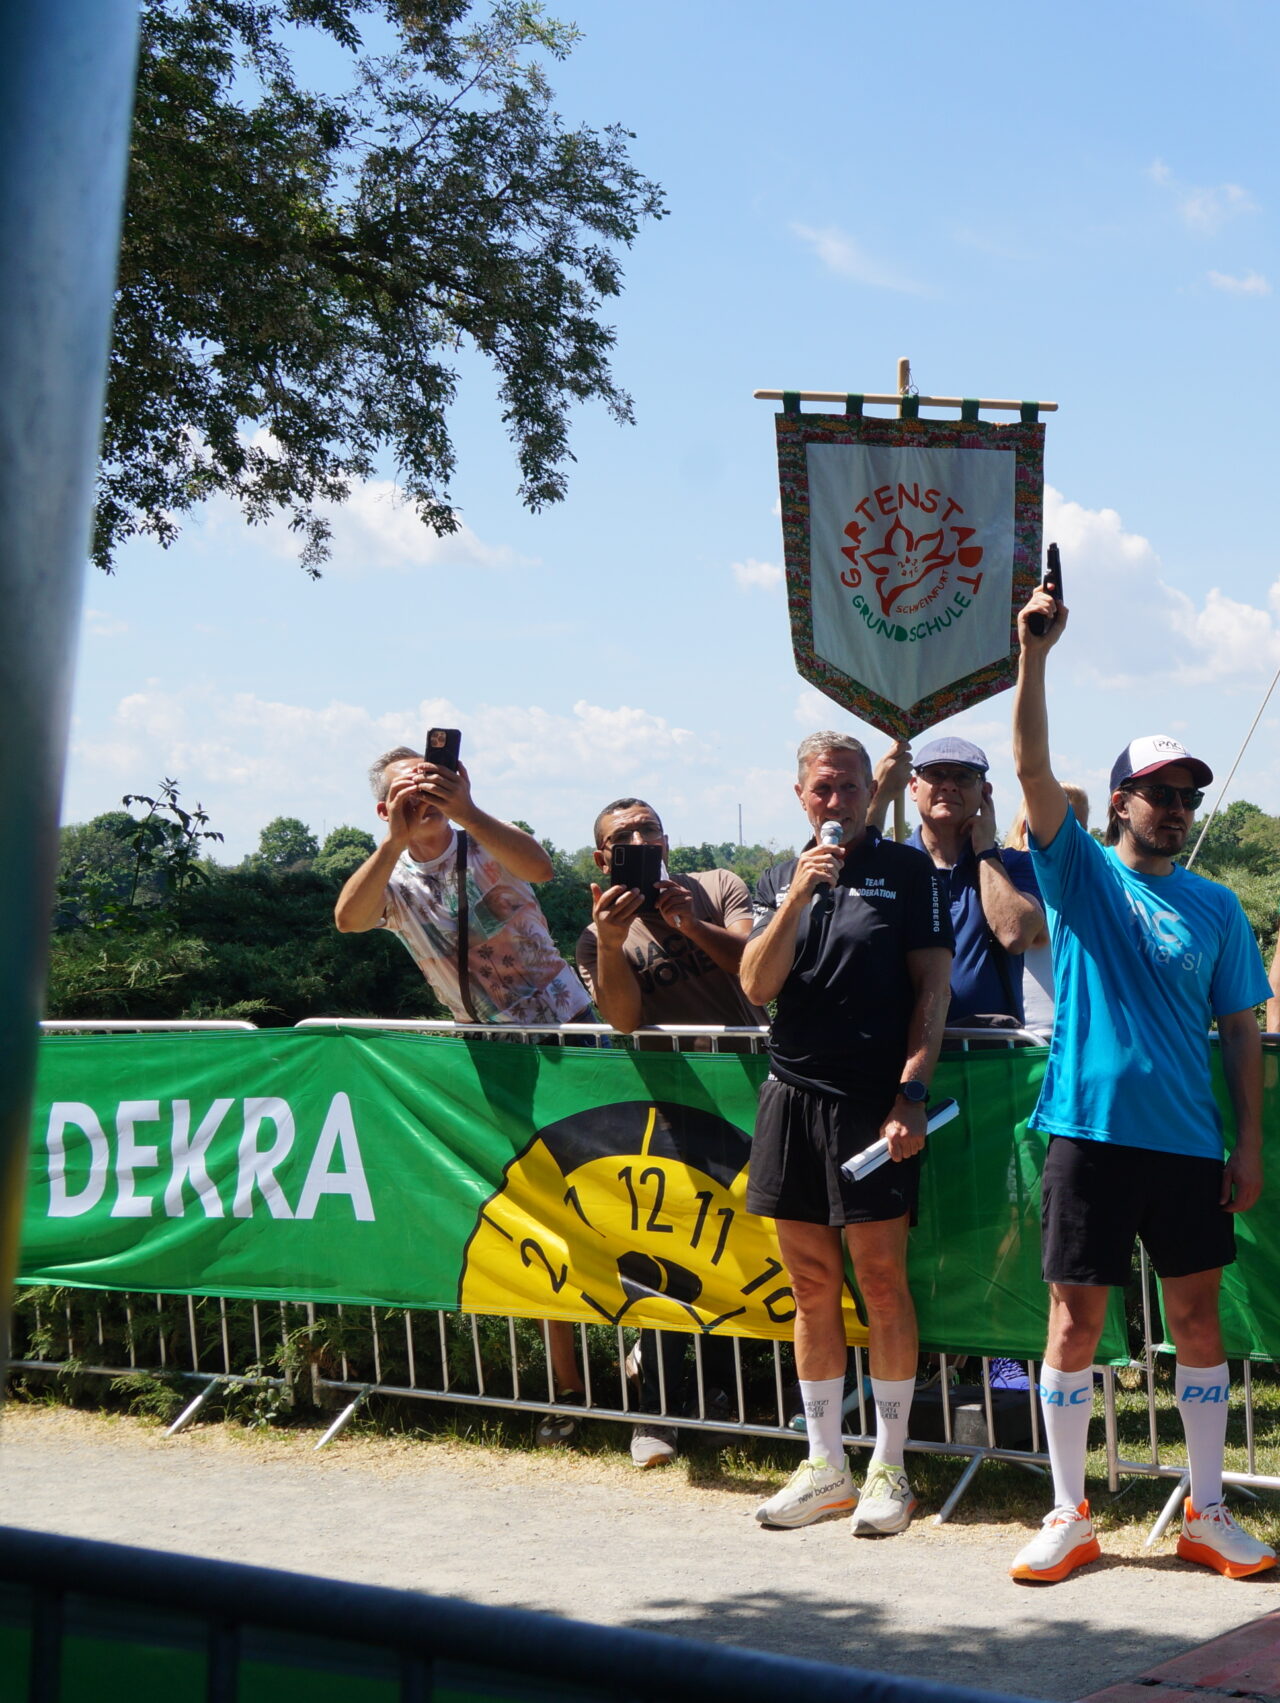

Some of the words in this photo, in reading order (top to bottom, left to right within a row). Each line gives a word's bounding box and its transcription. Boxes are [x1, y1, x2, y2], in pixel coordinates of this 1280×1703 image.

[840, 482, 984, 596] GARTENSTADT
[852, 591, 972, 643] GRUNDSCHULE
[848, 887, 897, 900] MODERATION
[864, 877, 885, 887] TEAM
[46, 1091, 376, 1222] DEKRA
[563, 1185, 607, 1238] 1
[617, 1166, 673, 1233] 12
[690, 1190, 735, 1266] 11
[520, 1237, 568, 1294] 2
[740, 1256, 797, 1324] 10
